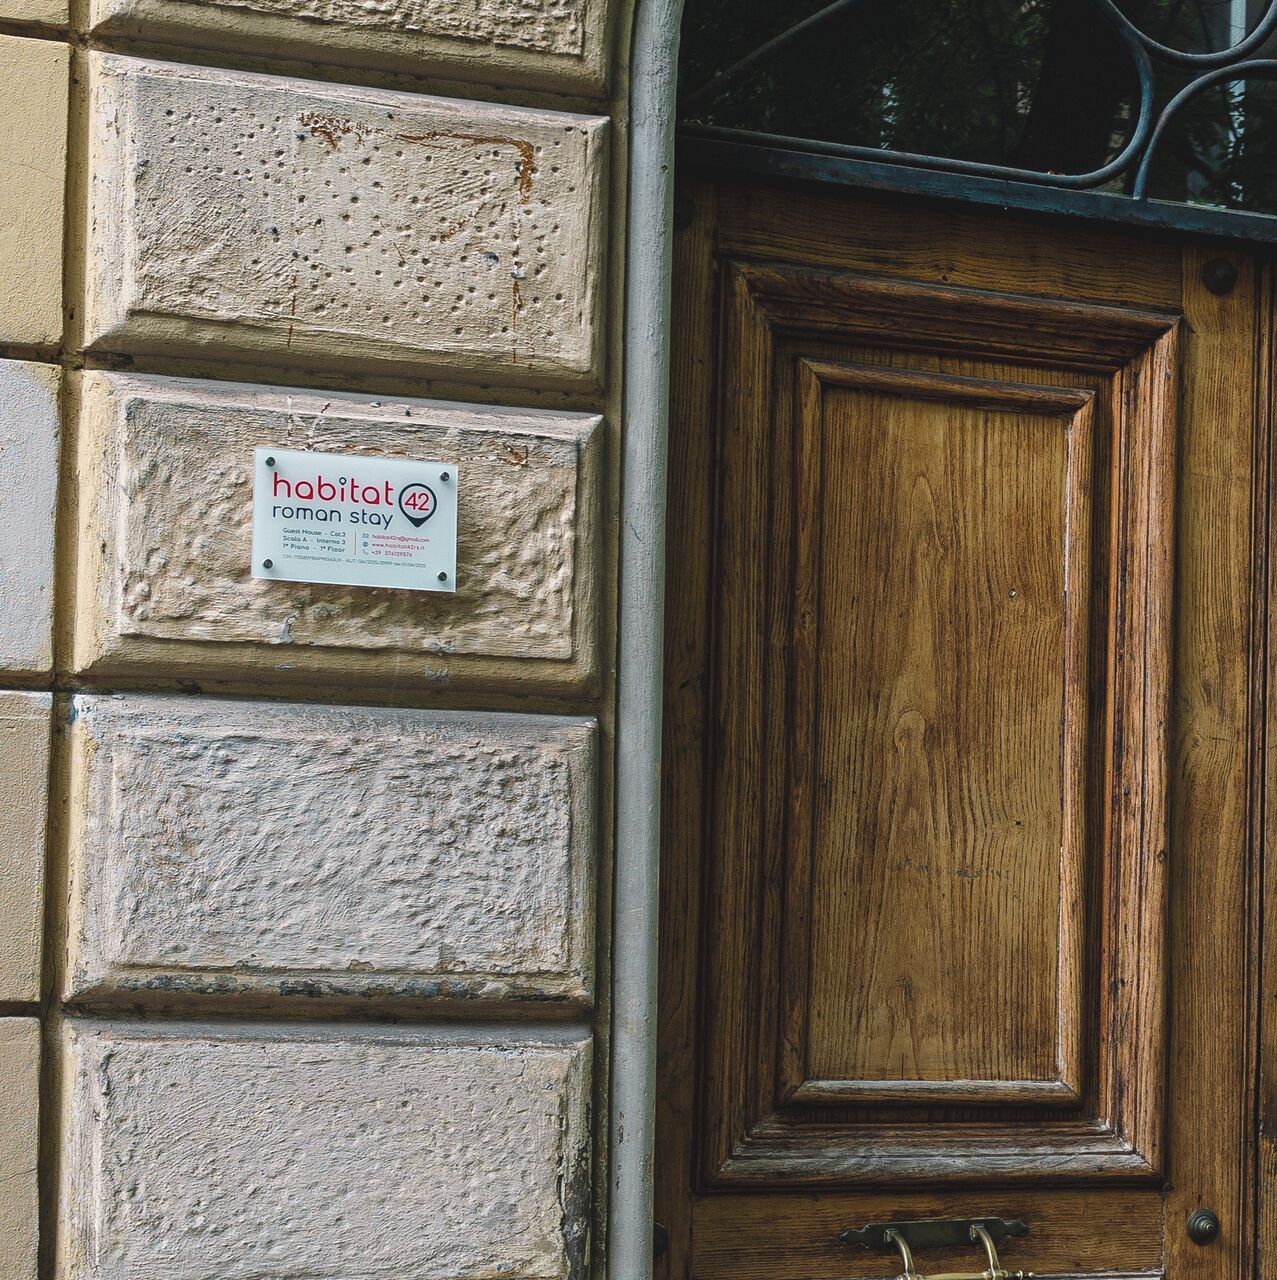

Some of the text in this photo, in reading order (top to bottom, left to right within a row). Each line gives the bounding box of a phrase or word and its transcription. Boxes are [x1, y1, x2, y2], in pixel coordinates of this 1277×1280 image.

[272, 471, 430, 512] habitat 42
[272, 505, 394, 530] roman stay
[282, 527, 301, 535] Guest
[290, 543, 310, 551] Piano
